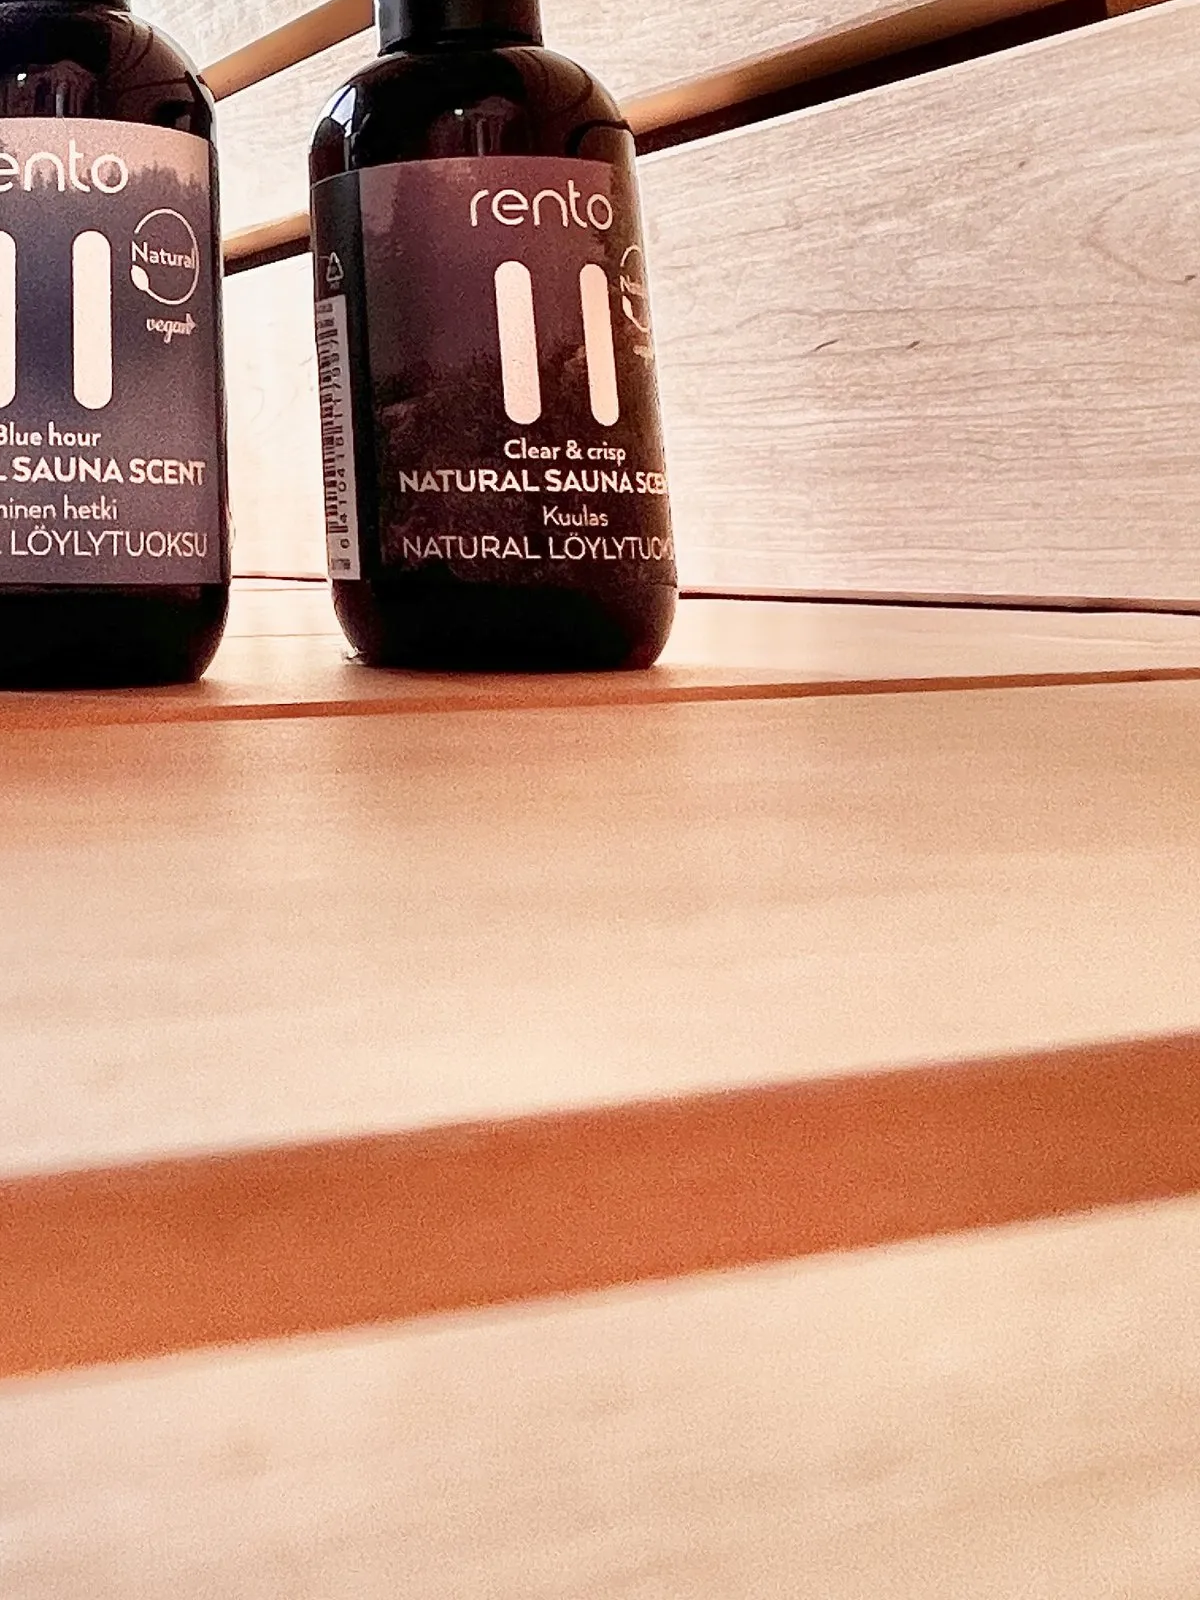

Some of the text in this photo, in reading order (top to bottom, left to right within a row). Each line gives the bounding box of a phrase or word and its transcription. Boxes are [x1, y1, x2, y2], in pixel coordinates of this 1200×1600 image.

[471, 180, 614, 231] rento
[131, 240, 196, 269] Natural
[146, 313, 196, 343] vegan
[49, 421, 102, 447] hour
[504, 437, 627, 467] Clear & crisp
[12, 456, 124, 483] SAUNA
[129, 458, 206, 486] SCENT
[399, 469, 668, 495] NATURAL SAUNA SCE
[63, 494, 118, 520] hetki
[542, 503, 609, 527] Kuulas
[11, 523, 208, 557] LÖYLYTUOKSU
[403, 531, 673, 560] NATURAL LÖYLYTUO
